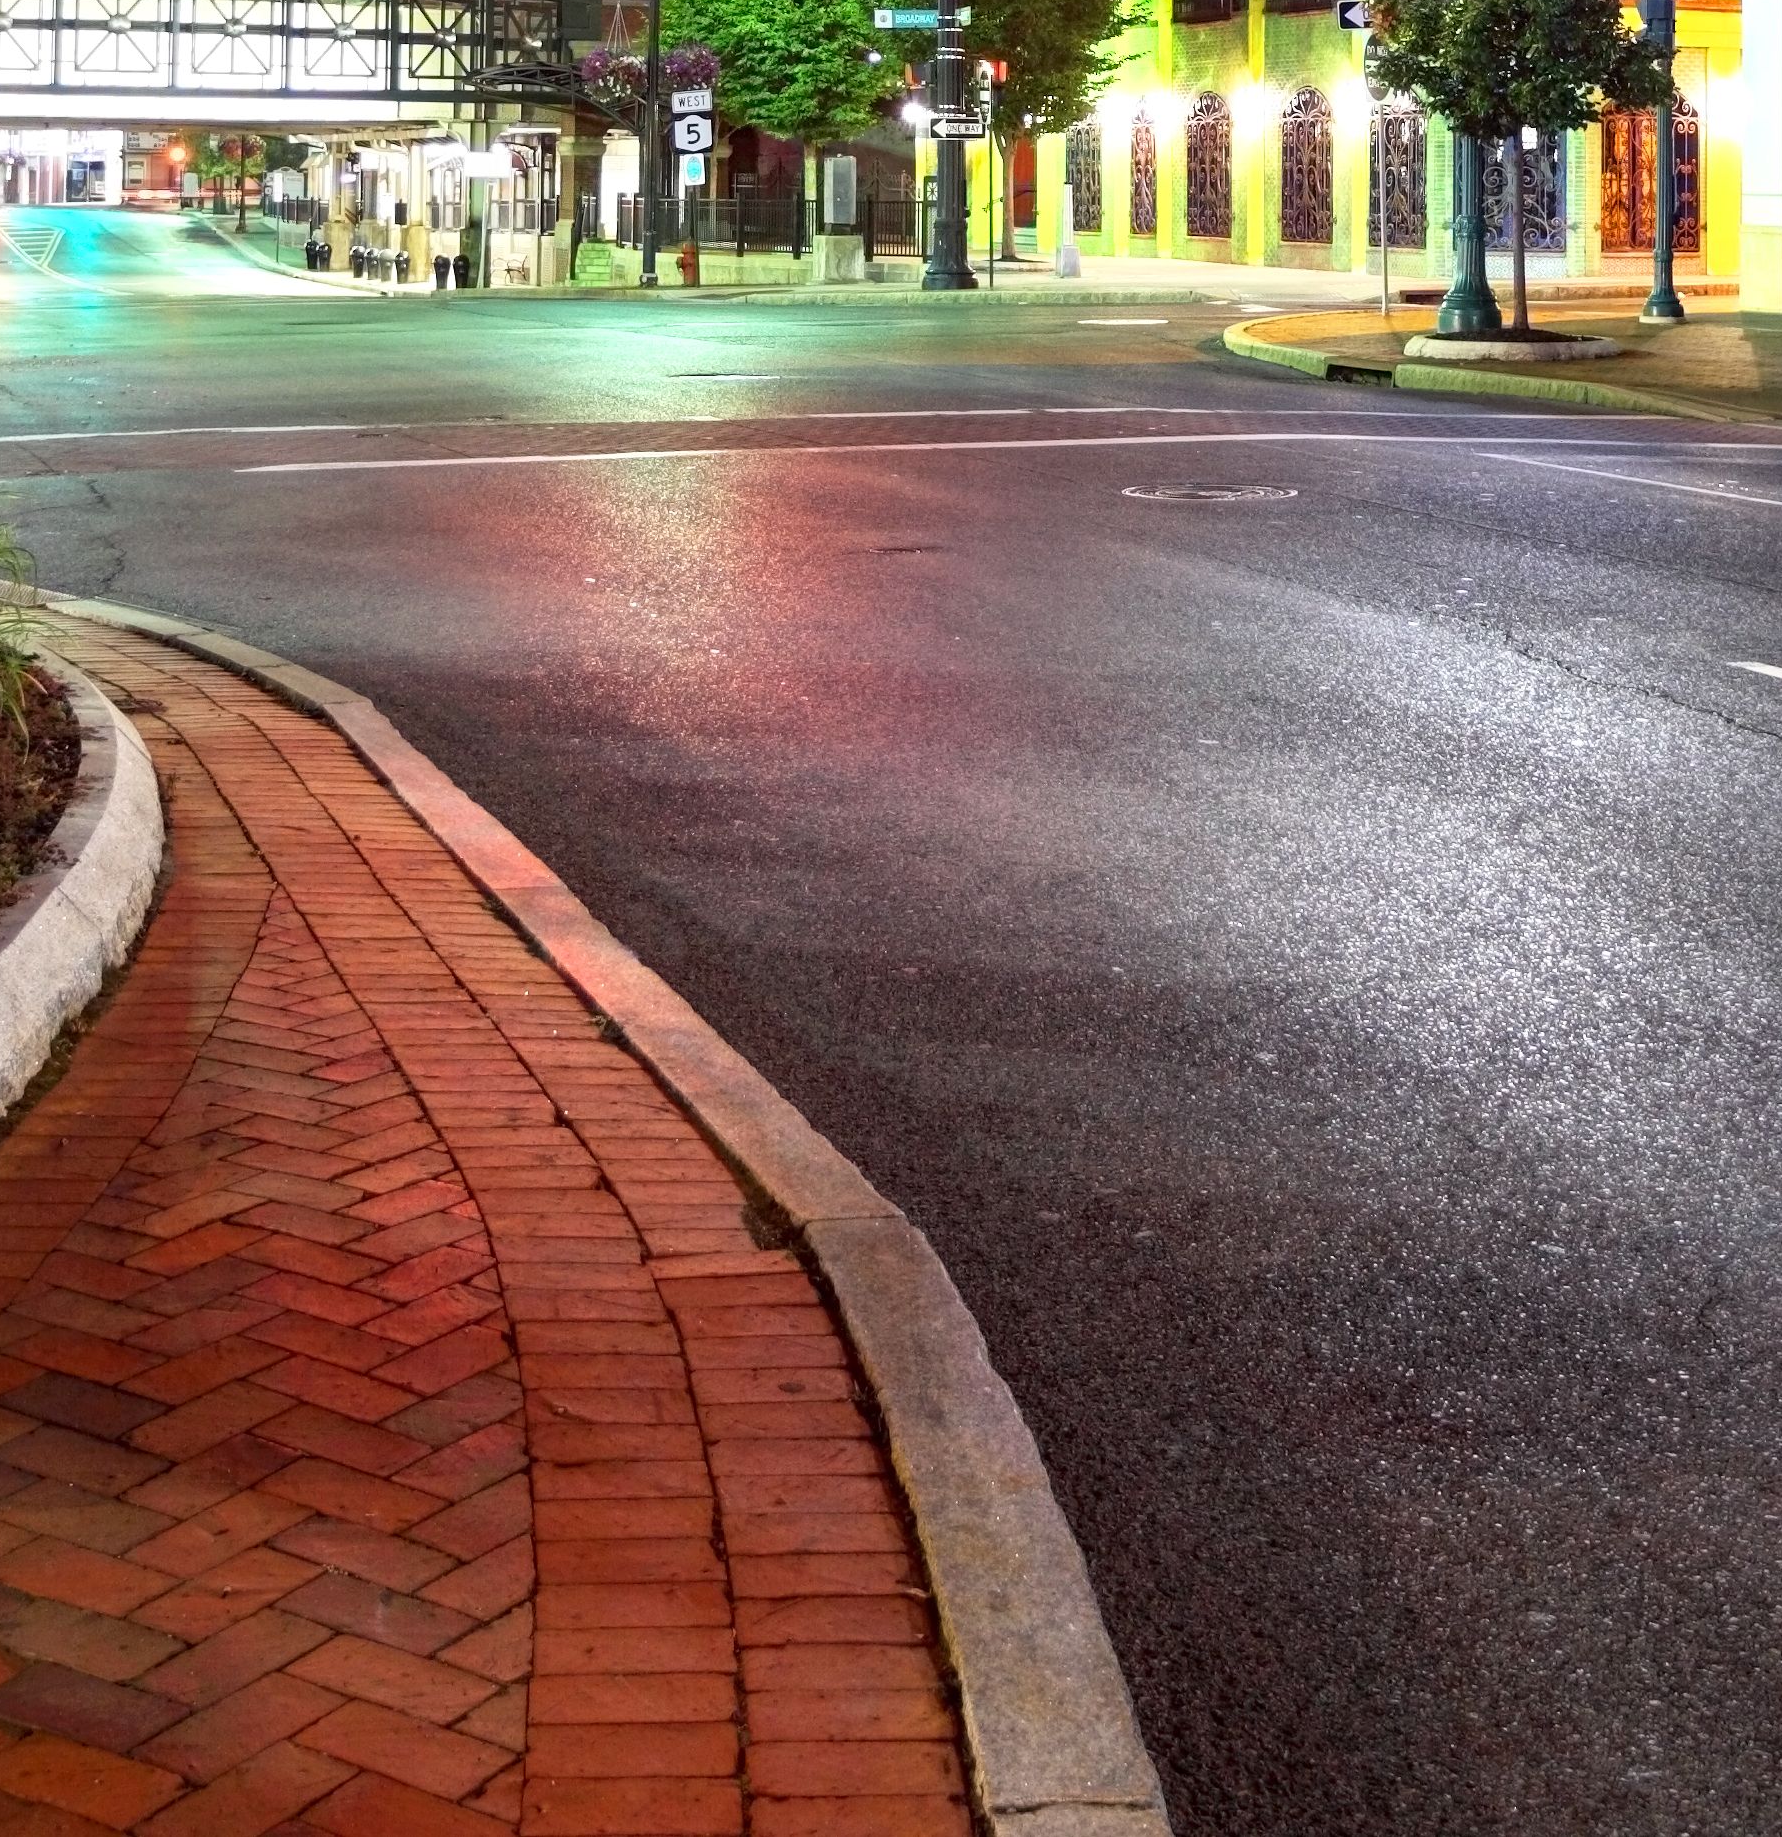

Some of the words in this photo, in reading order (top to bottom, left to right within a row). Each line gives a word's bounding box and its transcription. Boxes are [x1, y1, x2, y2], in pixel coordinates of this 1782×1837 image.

[895, 14, 935, 24] BROADWAY
[678, 95, 706, 108] WEST
[686, 124, 701, 144] 5
[947, 124, 963, 133] ONE
[964, 124, 980, 133] WAY
